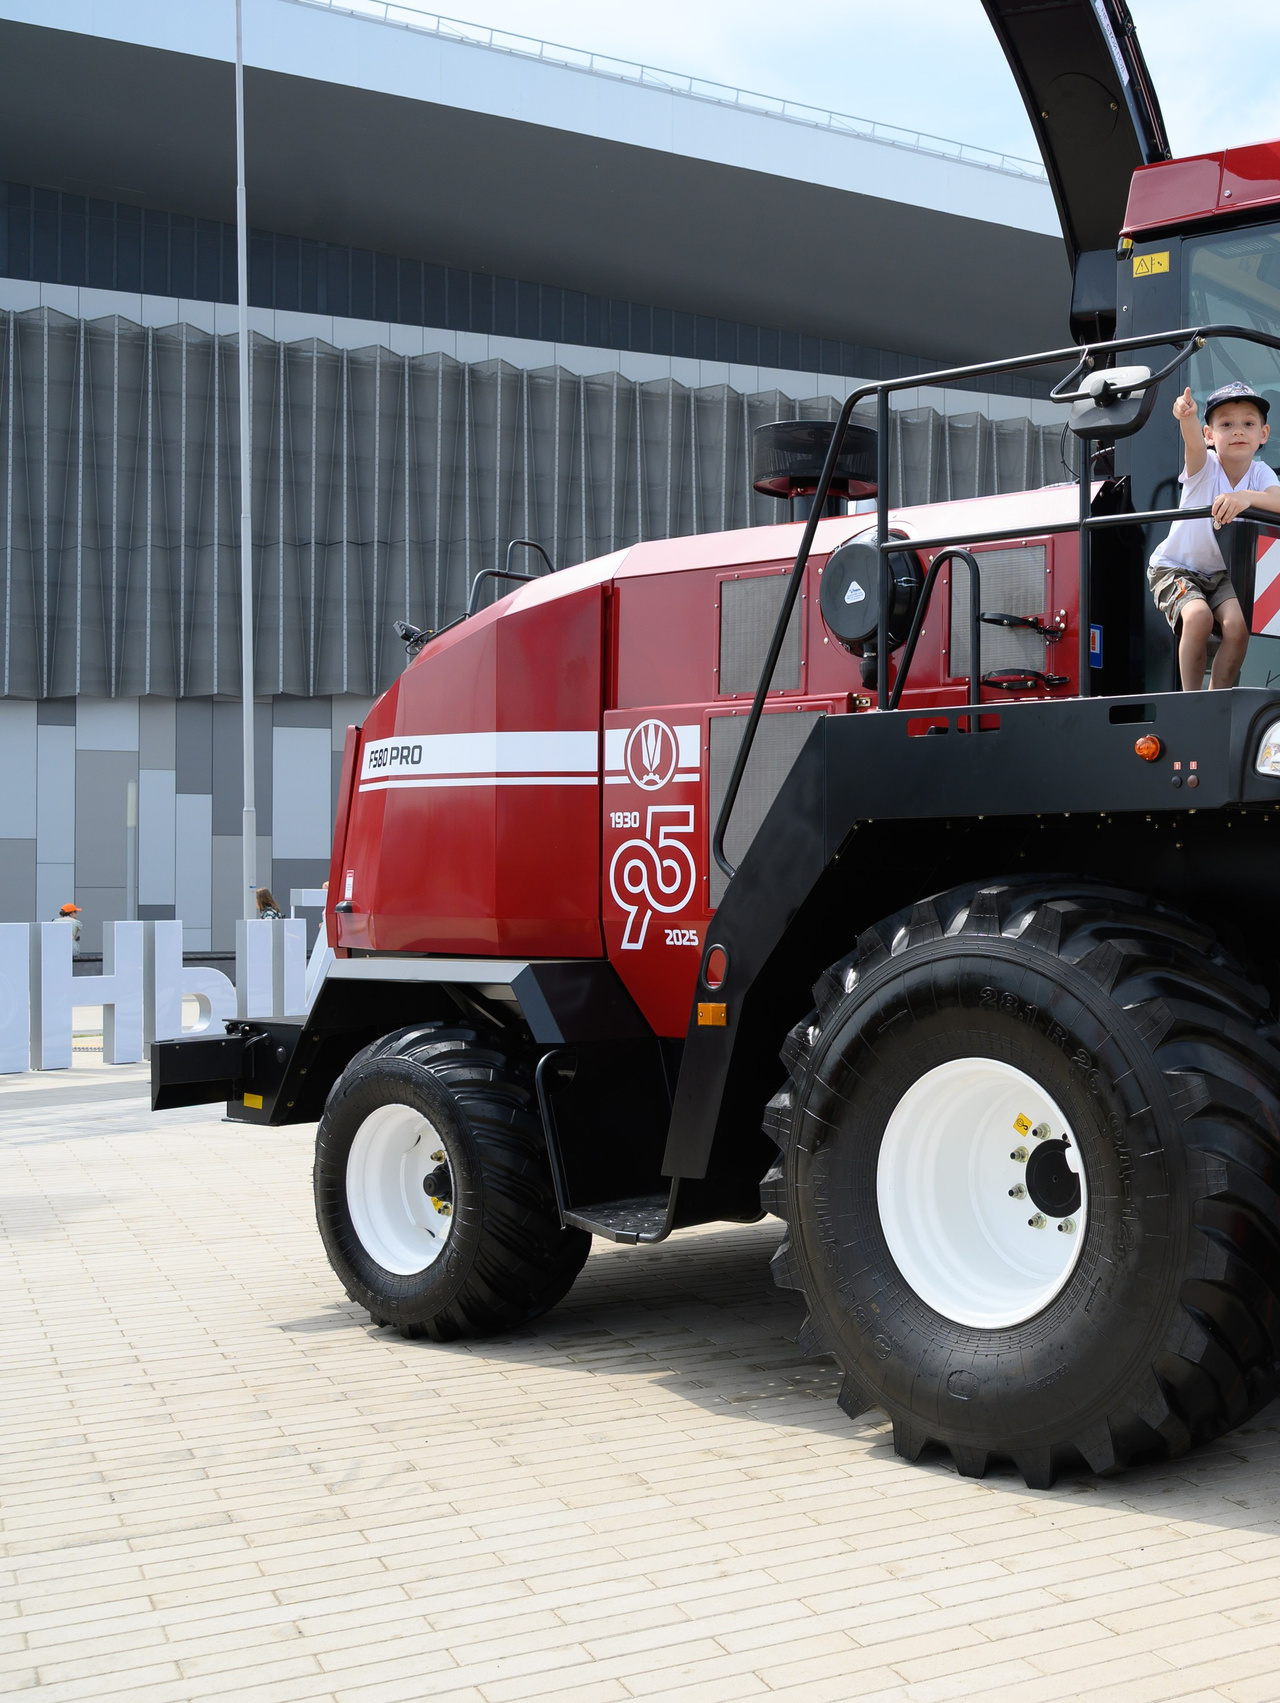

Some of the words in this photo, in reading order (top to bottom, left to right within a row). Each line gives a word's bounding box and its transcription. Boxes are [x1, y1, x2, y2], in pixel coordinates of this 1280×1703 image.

[389, 745, 423, 766] PRO
[609, 811, 640, 828] 1930
[664, 929, 699, 946] 2025
[978, 986, 1040, 1028] 28.1
[1046, 1017, 1070, 1049] R
